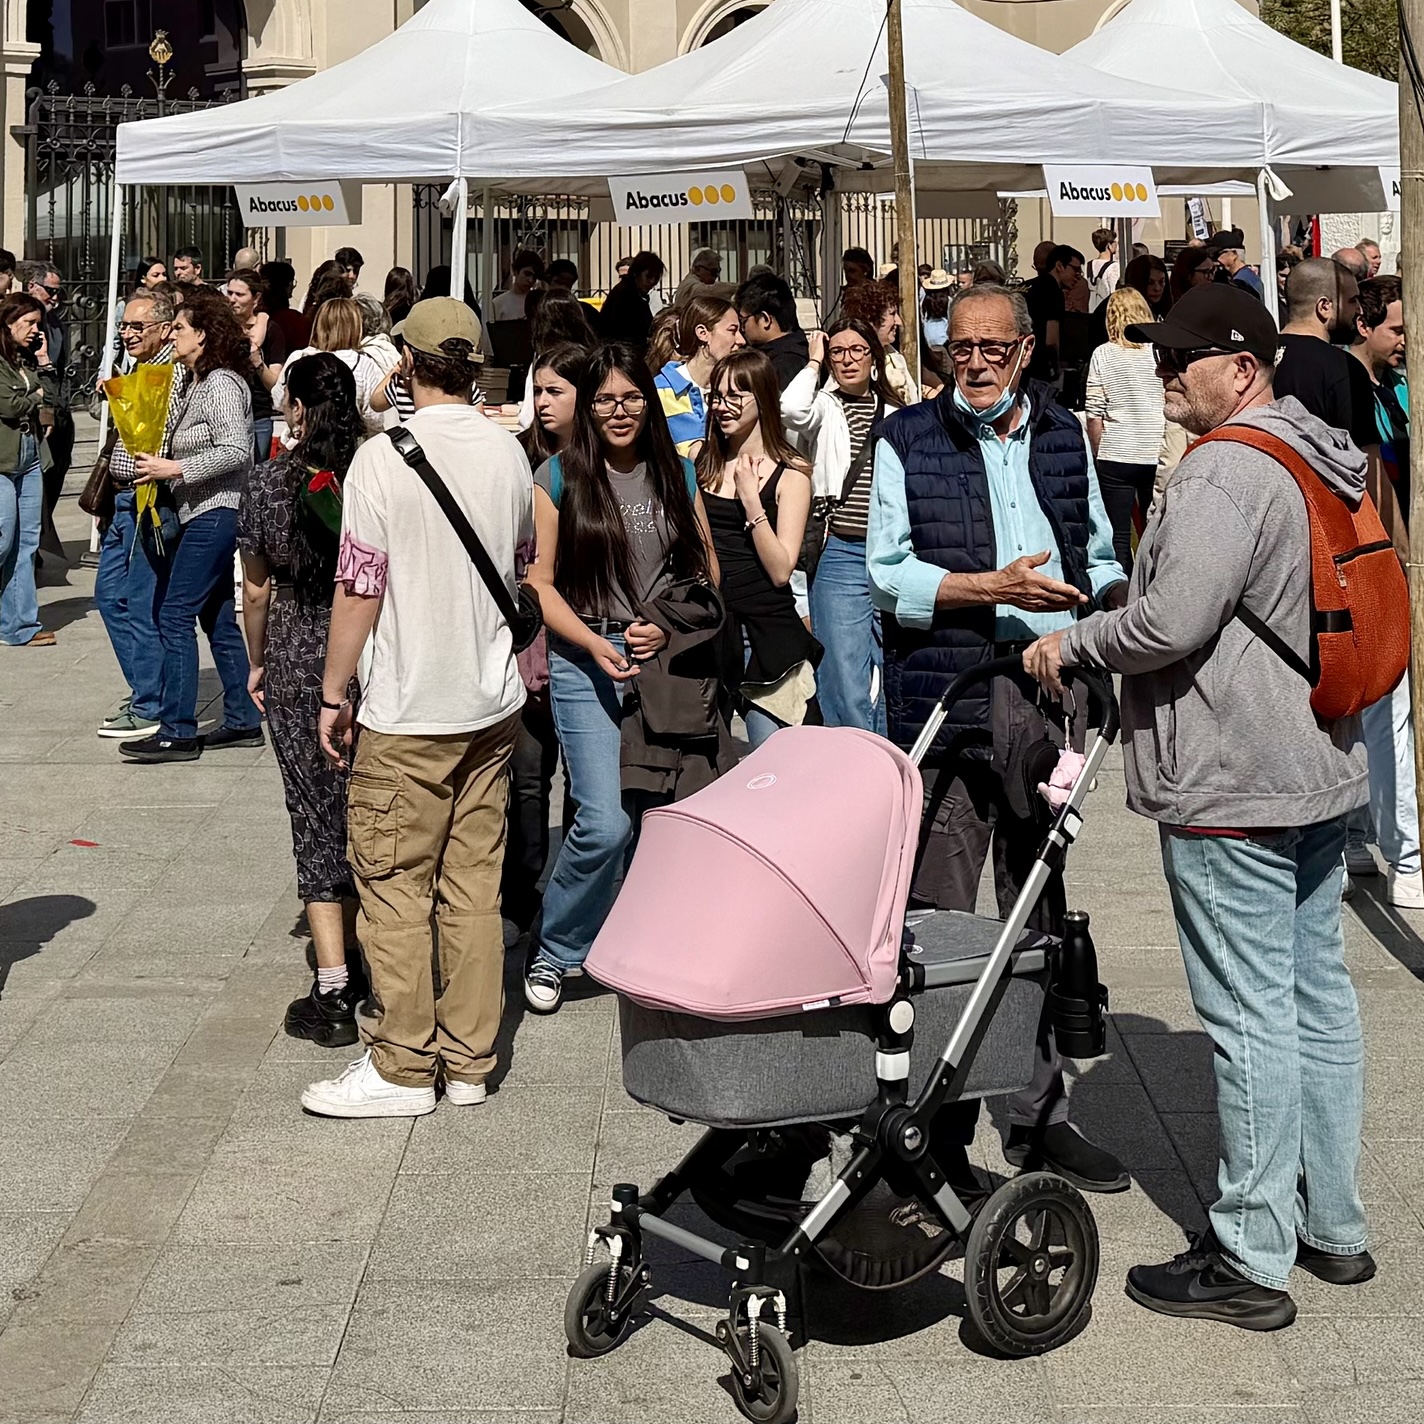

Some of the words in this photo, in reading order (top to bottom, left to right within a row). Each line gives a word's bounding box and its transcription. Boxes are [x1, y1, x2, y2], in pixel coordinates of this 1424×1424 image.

[626, 190, 688, 210] Abacus
[1059, 181, 1111, 201] Abacus
[249, 196, 298, 213] Abacus
